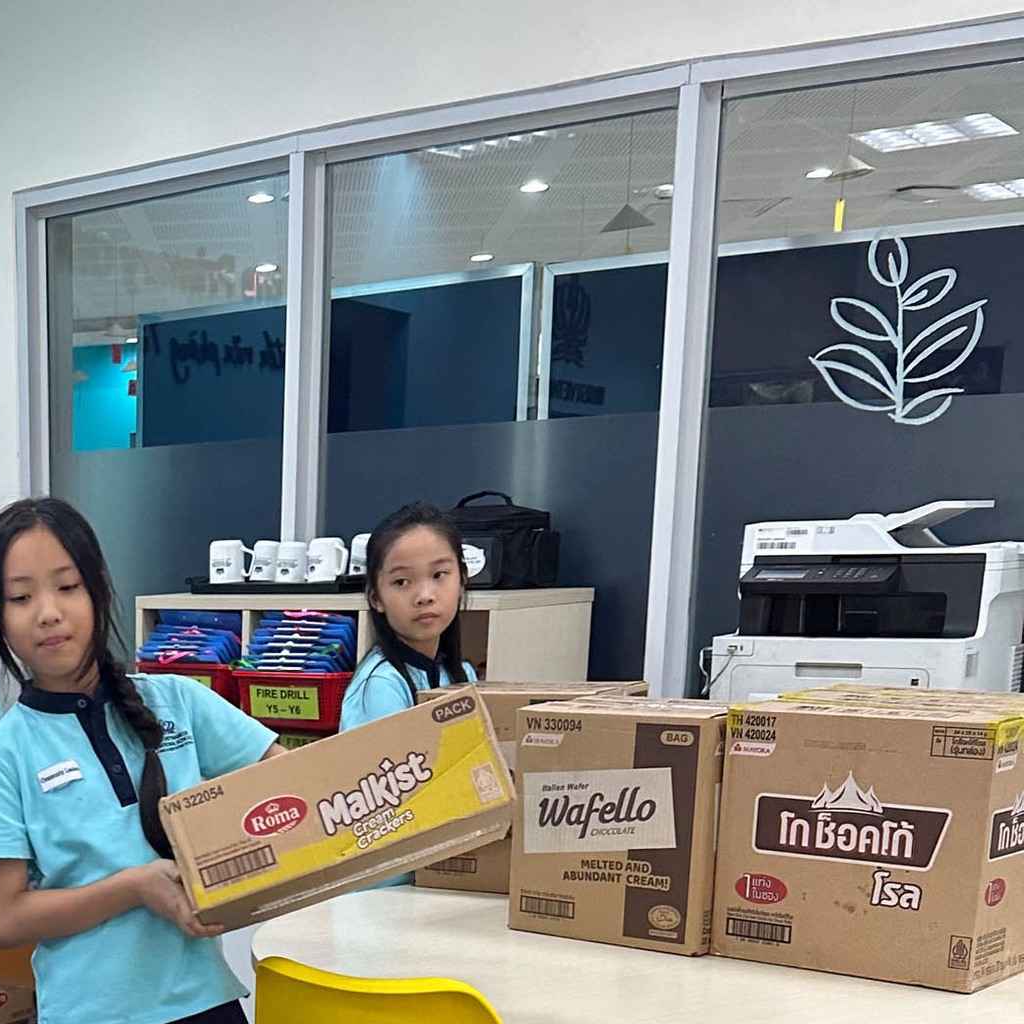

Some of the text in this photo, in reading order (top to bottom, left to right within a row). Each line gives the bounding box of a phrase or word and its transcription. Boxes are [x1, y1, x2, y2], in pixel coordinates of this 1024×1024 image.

[255, 688, 310, 701] FIRE DRILL
[434, 698, 473, 722] PACK
[525, 716, 583, 732] VN 330094
[731, 715, 777, 728] TH 420017
[665, 732, 689, 743] BAG
[730, 727, 777, 741] VN 420024
[162, 784, 226, 816] VN 322054
[318, 750, 434, 837] Malkist
[252, 804, 302, 833] Roma
[352, 805, 398, 838] Cream
[537, 786, 657, 840] Wafello
[356, 808, 415, 850] Crackers
[590, 826, 636, 837] CHOCOLATE
[580, 859, 650, 874] MELTED AND
[562, 871, 670, 889] ABUNDANT CREAM!
[870, 869, 923, 911] โรล
